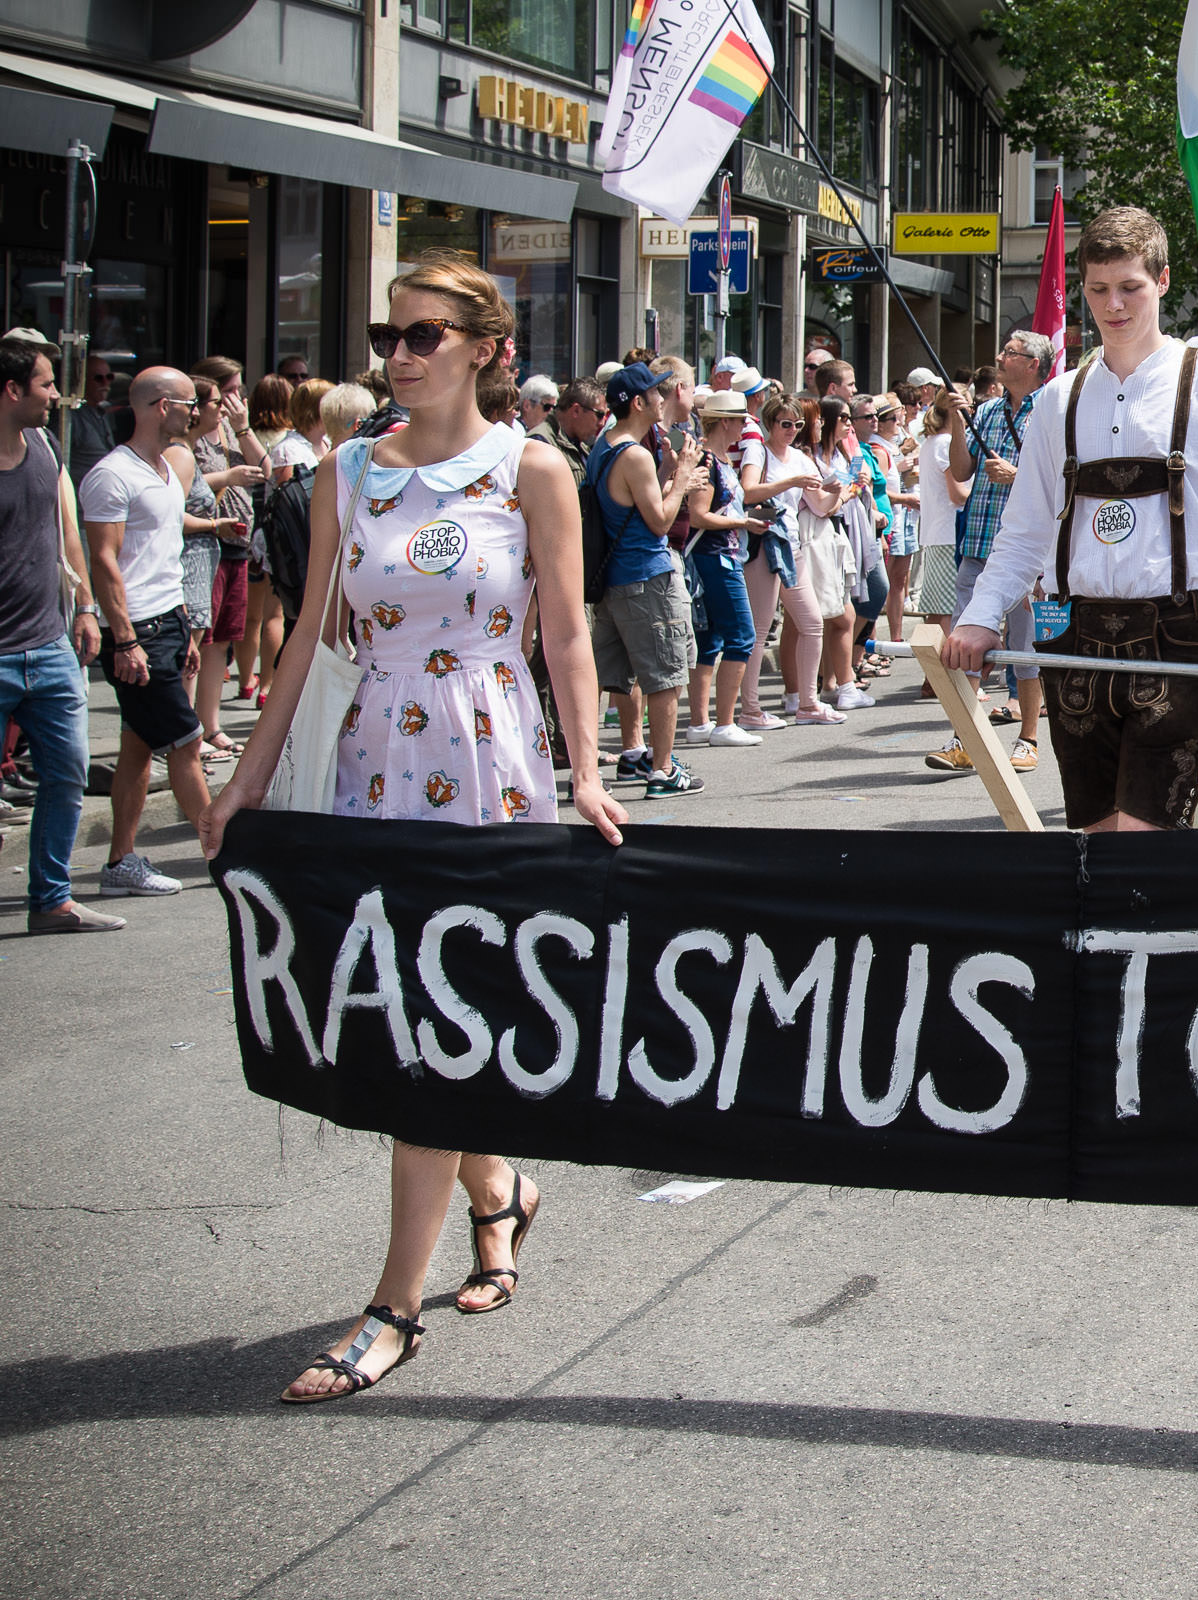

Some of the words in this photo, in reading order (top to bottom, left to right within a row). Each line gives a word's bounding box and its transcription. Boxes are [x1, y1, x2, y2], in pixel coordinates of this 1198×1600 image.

[479, 76, 589, 144] HEIDEN
[902, 225, 954, 239] Galerie
[959, 226, 992, 238] Otto
[691, 237, 747, 252] Parksein
[1100, 504, 1126, 516] STOP
[1097, 512, 1131, 526] HOMO
[420, 526, 456, 539] STOP
[1097, 521, 1132, 535] PHOBIA
[414, 536, 461, 551] HOMO
[413, 546, 460, 560] PHOBIA
[224, 867, 1036, 1134] RASSISMUS
